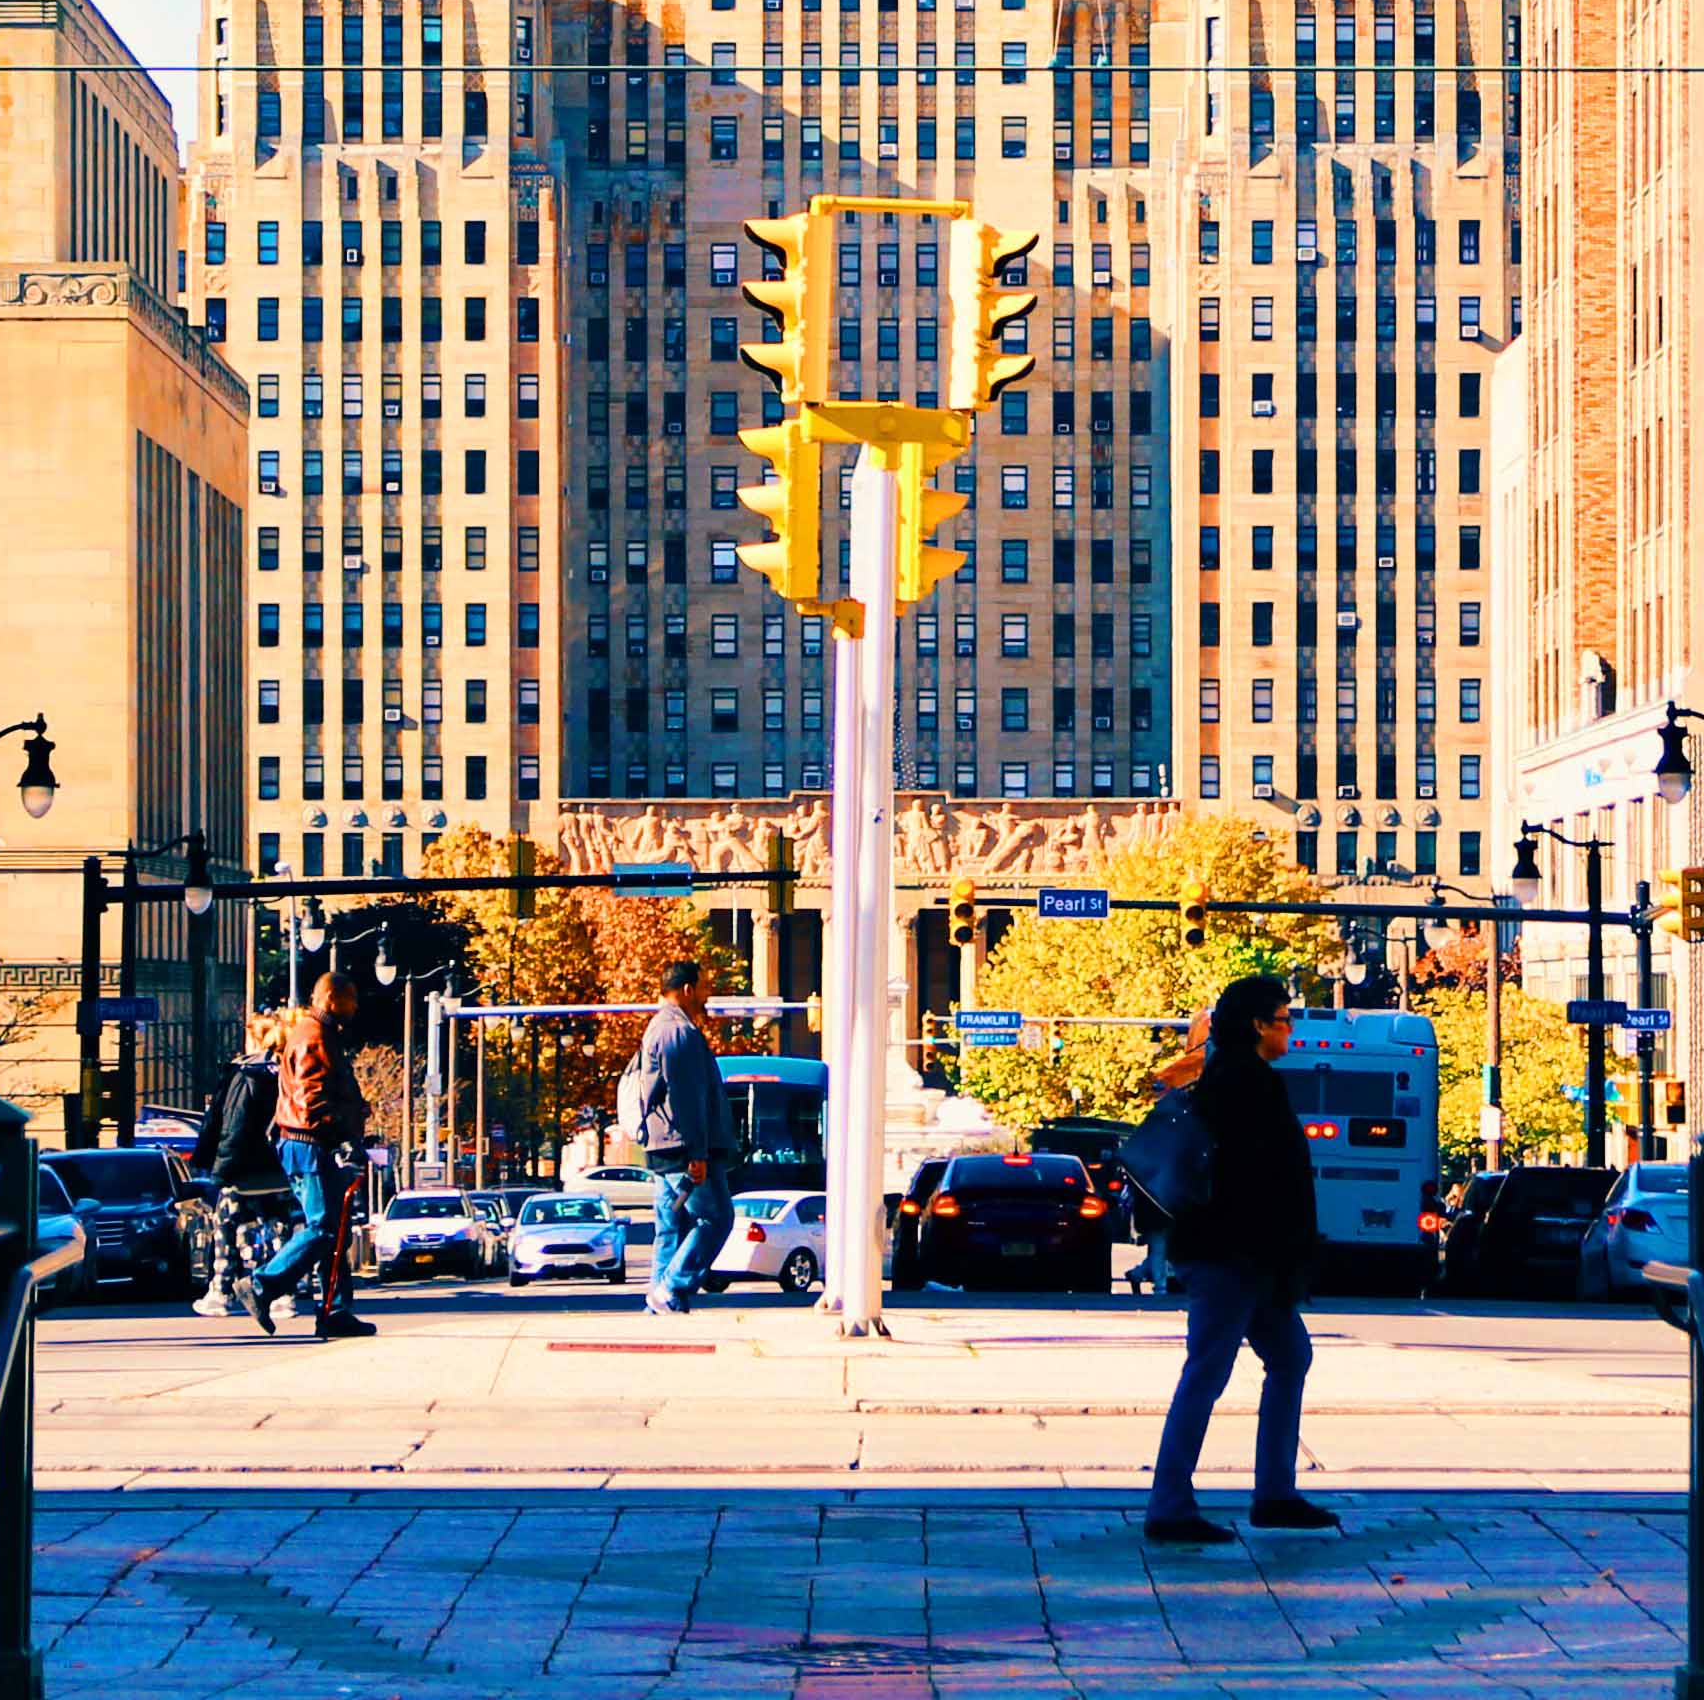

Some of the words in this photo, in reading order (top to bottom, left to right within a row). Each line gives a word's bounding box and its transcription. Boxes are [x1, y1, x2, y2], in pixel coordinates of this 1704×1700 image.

[1044, 896, 1085, 912] Pearl
[1090, 897, 1102, 910] St
[960, 1014, 1009, 1026] FRANKLIN
